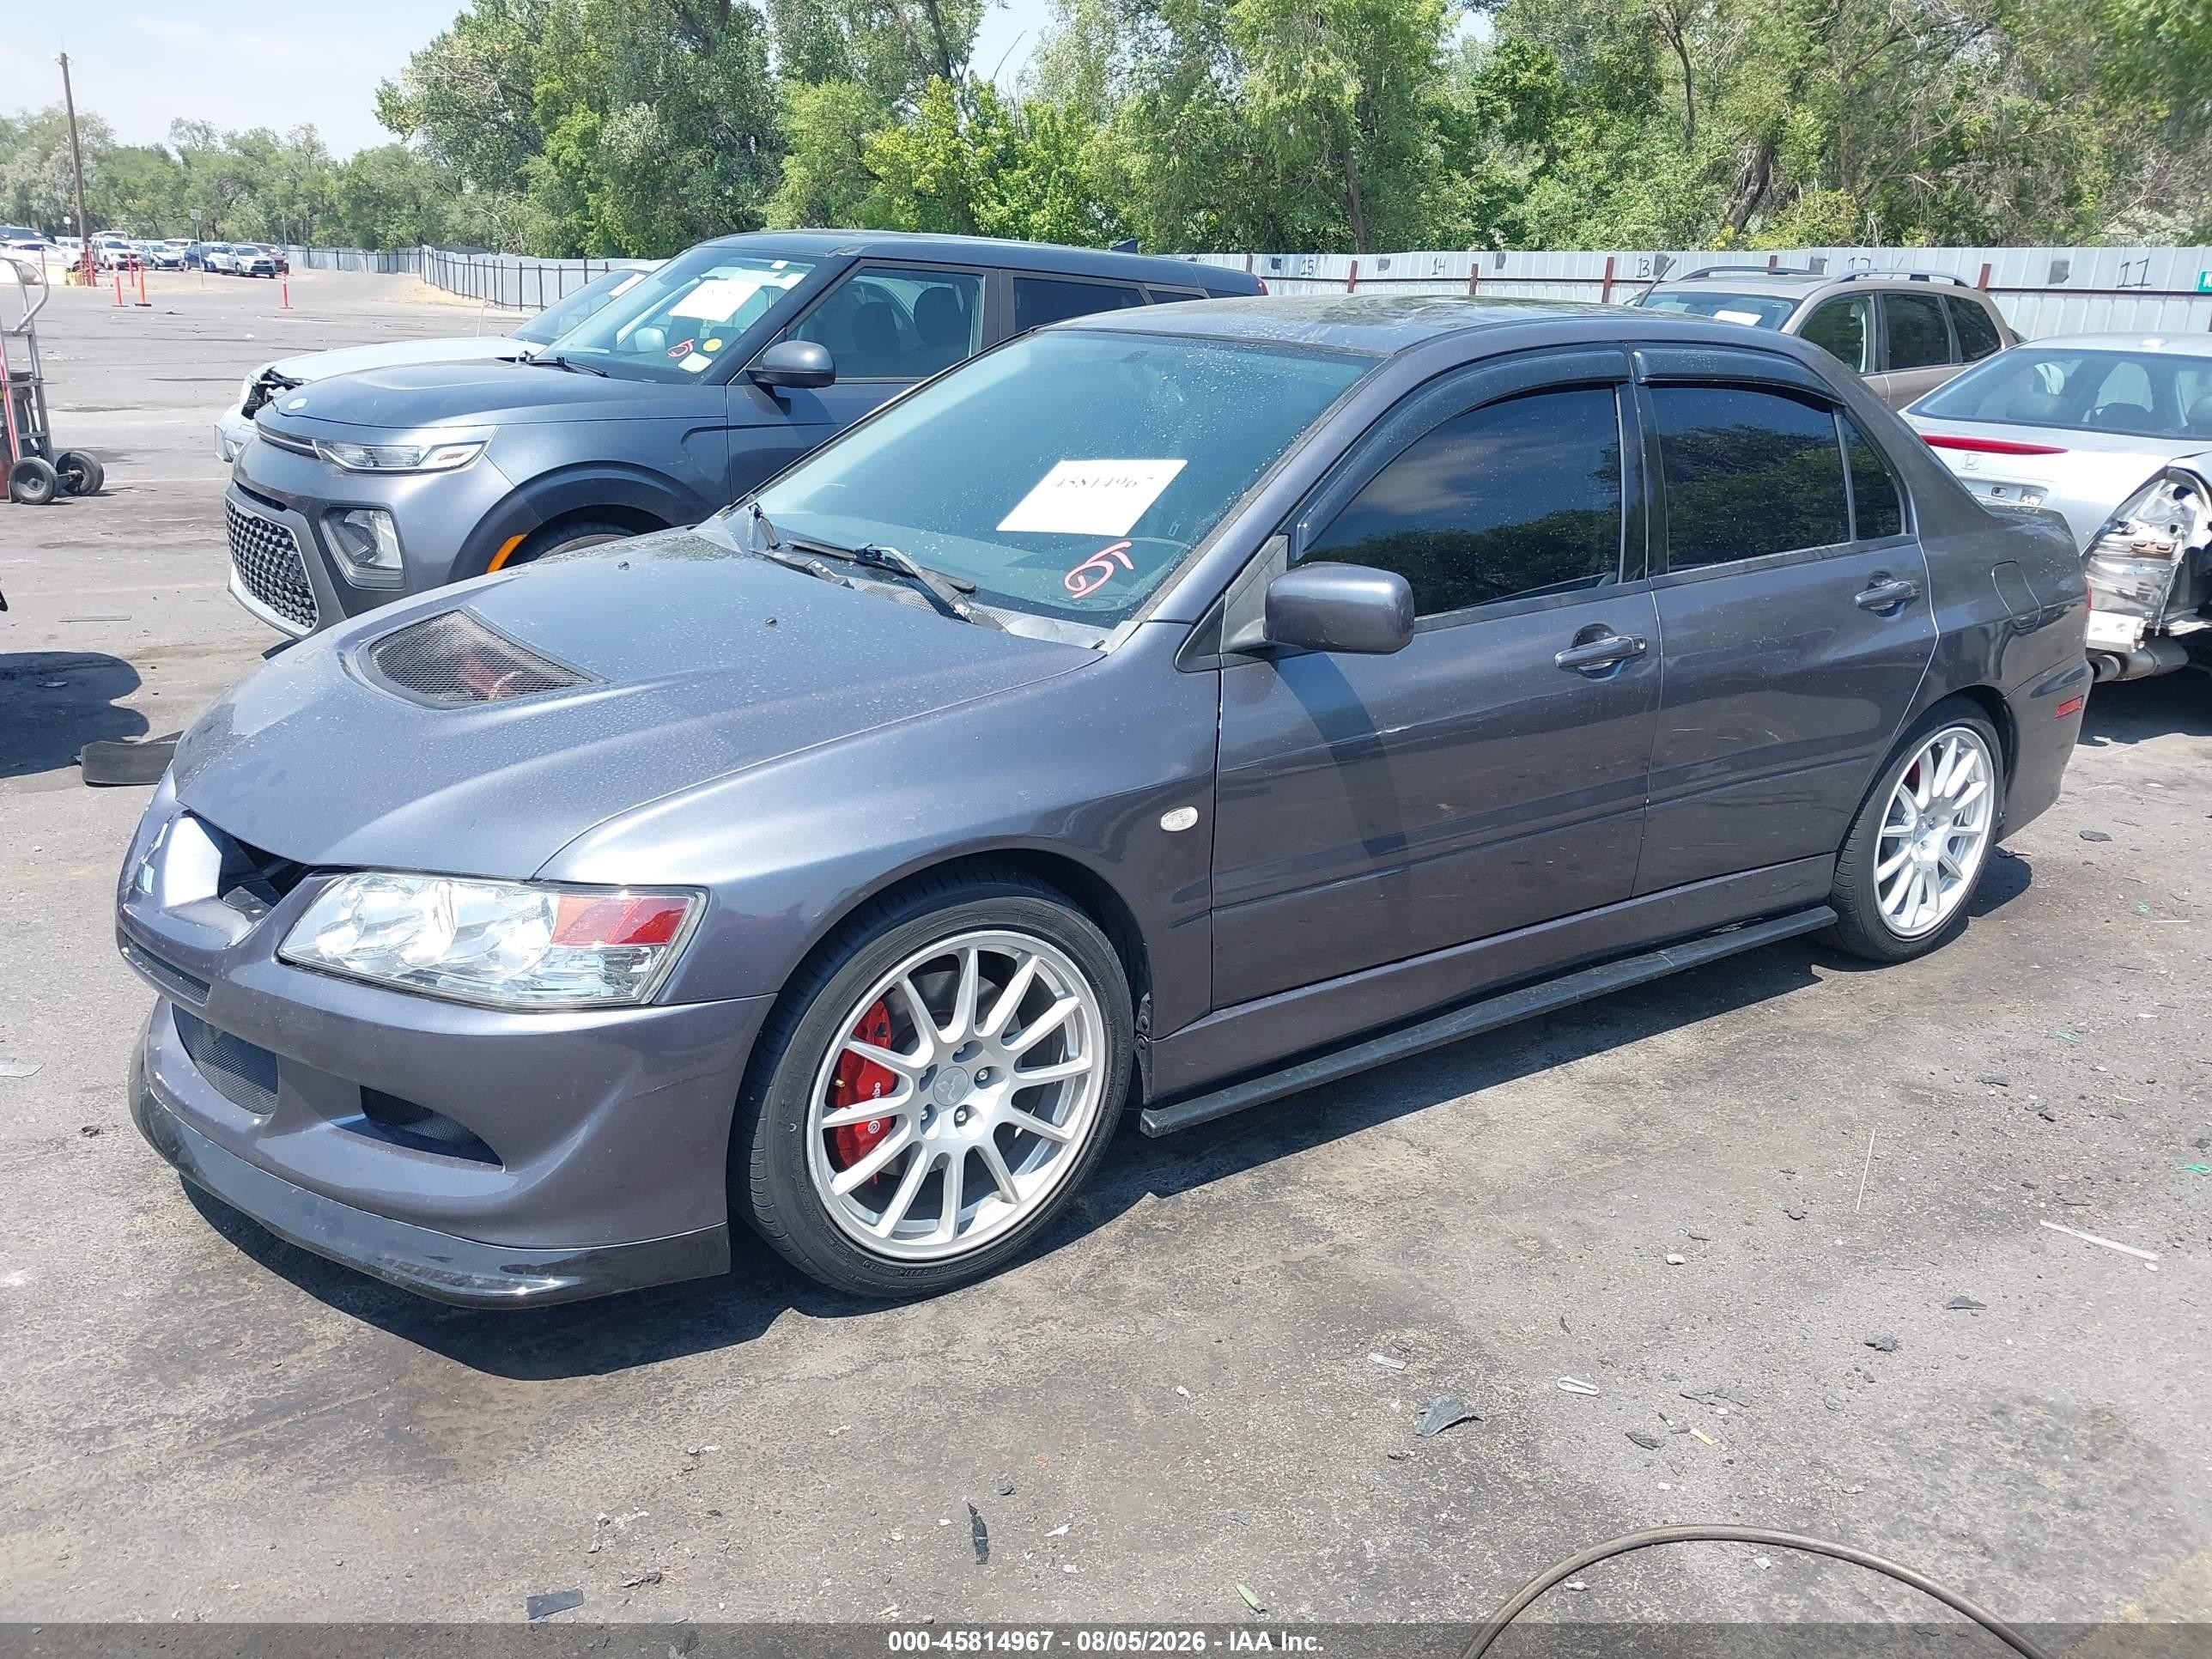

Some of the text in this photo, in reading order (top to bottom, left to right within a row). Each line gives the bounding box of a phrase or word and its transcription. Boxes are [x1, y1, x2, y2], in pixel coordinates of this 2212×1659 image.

[1301, 258, 1314, 276] 15
[1431, 257, 1446, 276] 14
[1636, 257, 1650, 278] 13
[2116, 258, 2152, 289] 11
